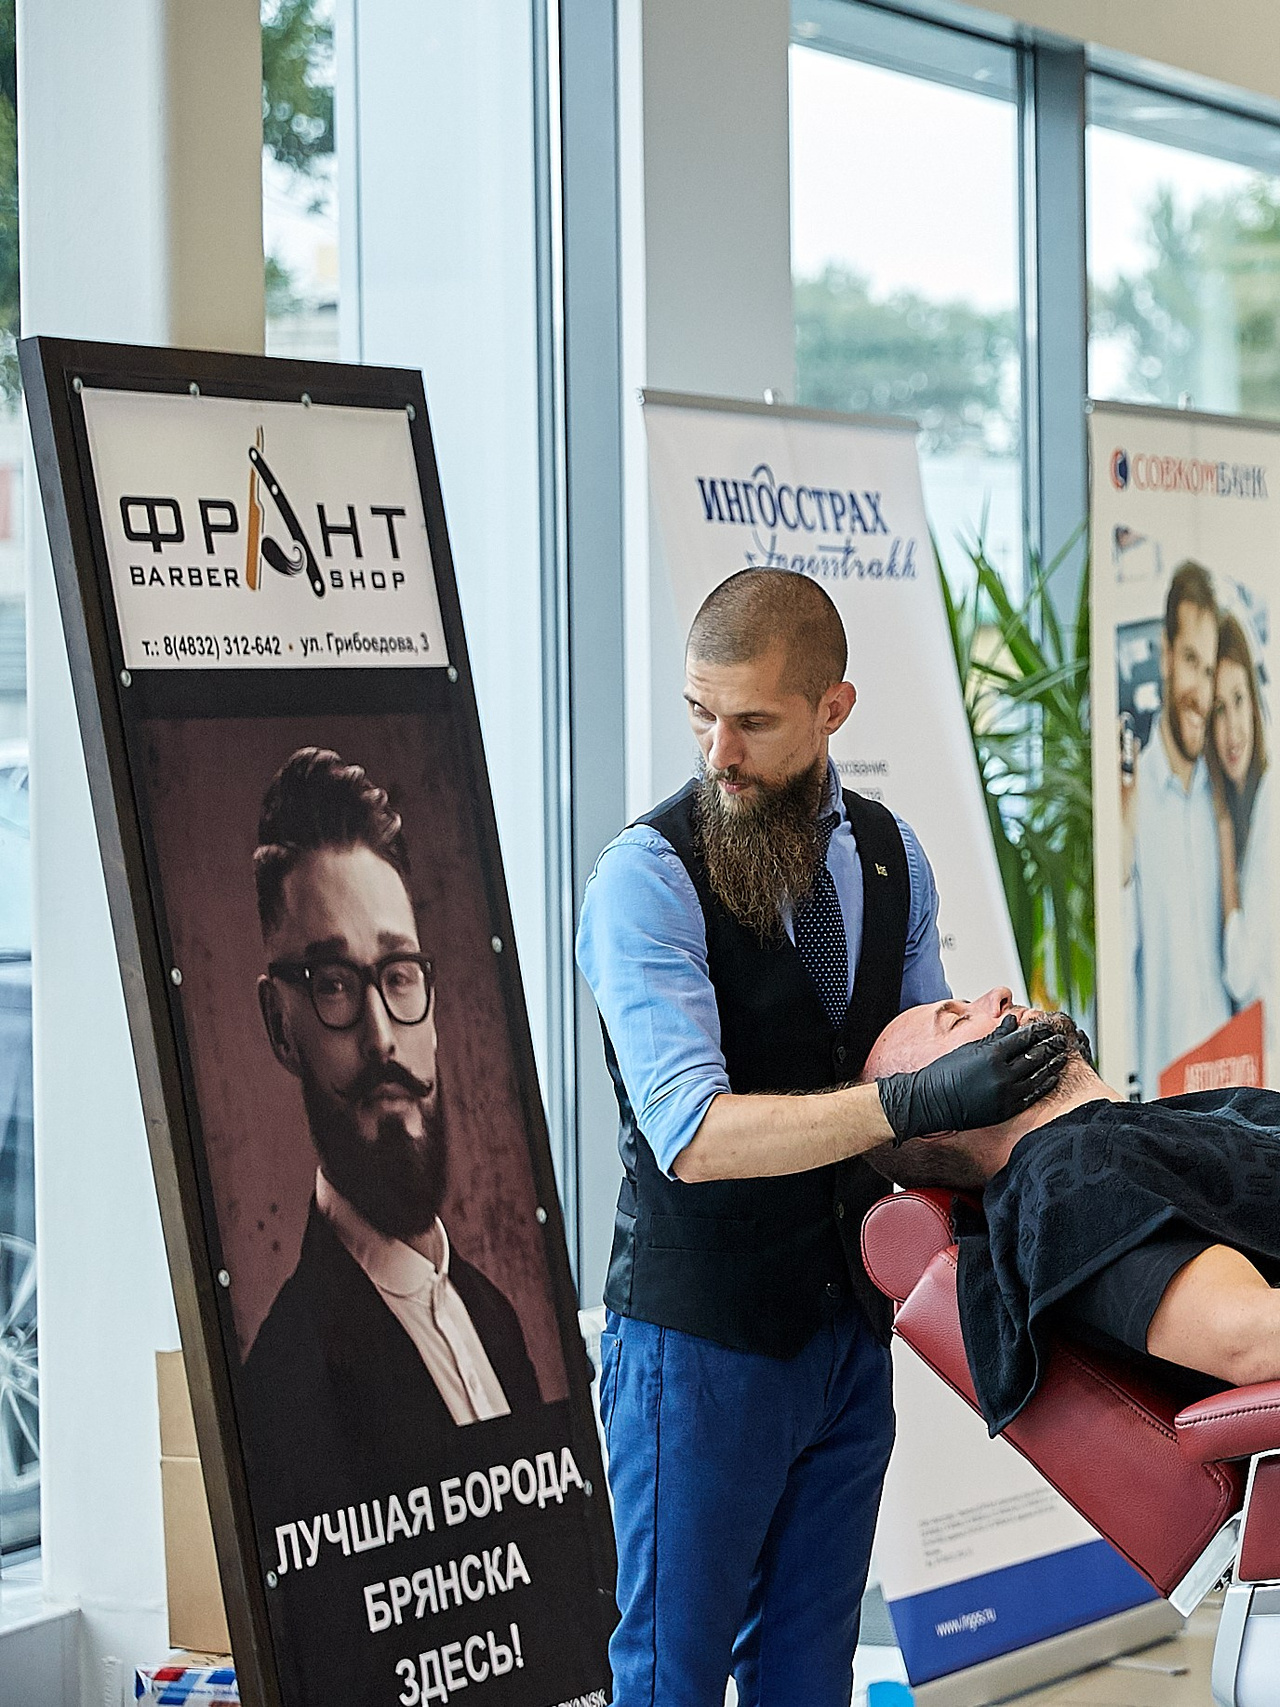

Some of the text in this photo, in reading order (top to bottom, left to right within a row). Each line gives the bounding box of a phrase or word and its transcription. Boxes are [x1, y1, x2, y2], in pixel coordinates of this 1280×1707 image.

[119, 425, 406, 598] ФРАНТ
[696, 466, 890, 536] ИНГОССТРАХ
[130, 565, 405, 591] BARBER SHOP
[163, 634, 220, 661] 8(4832)
[223, 635, 282, 657] 312-642
[300, 637, 324, 657] ул.
[420, 632, 430, 652] 3
[274, 1446, 585, 1576] ЛУЧШАЯ БОРОДА
[362, 1541, 532, 1634] БРЯНСКА
[394, 1622, 527, 1707] ЗДЕСЬ!
